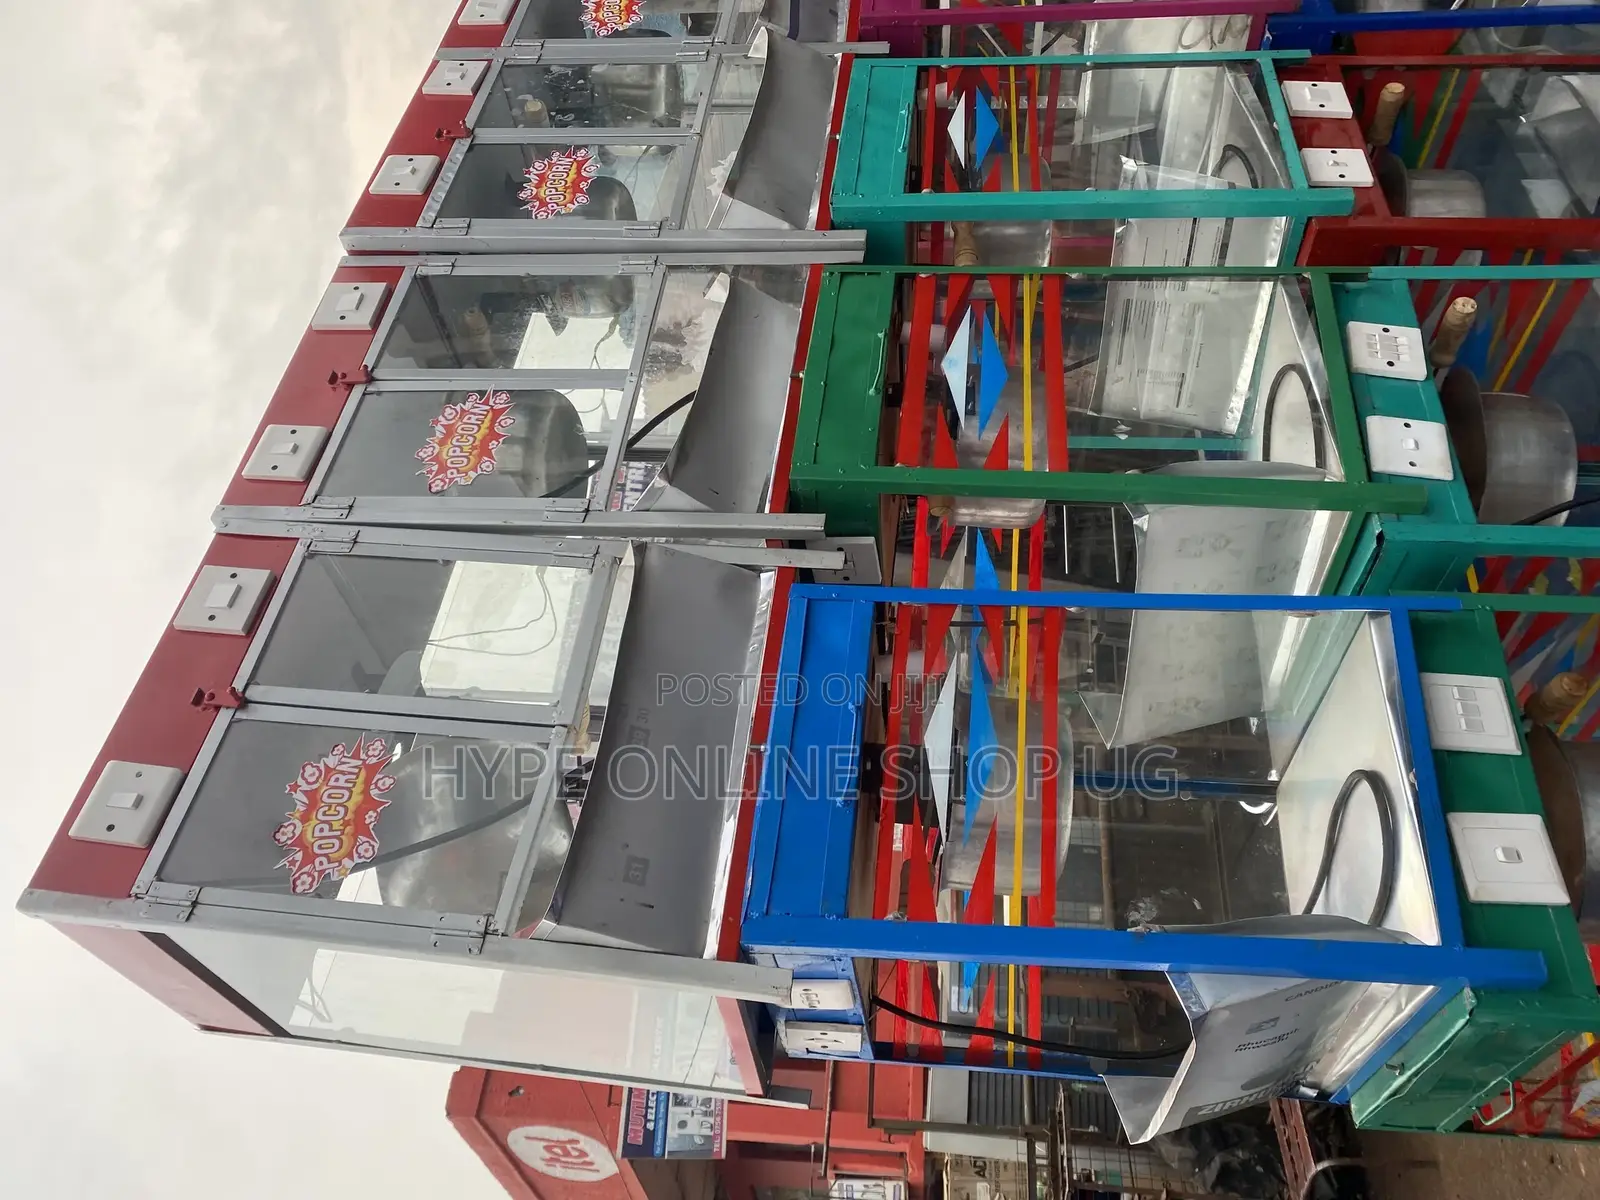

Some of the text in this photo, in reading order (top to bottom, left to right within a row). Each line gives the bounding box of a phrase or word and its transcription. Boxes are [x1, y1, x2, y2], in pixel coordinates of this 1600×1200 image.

[545, 157, 575, 210] POPCORN
[445, 402, 491, 479] POPCORN
[313, 756, 363, 871] POPCORN
[646, 1120, 655, 1131] &
